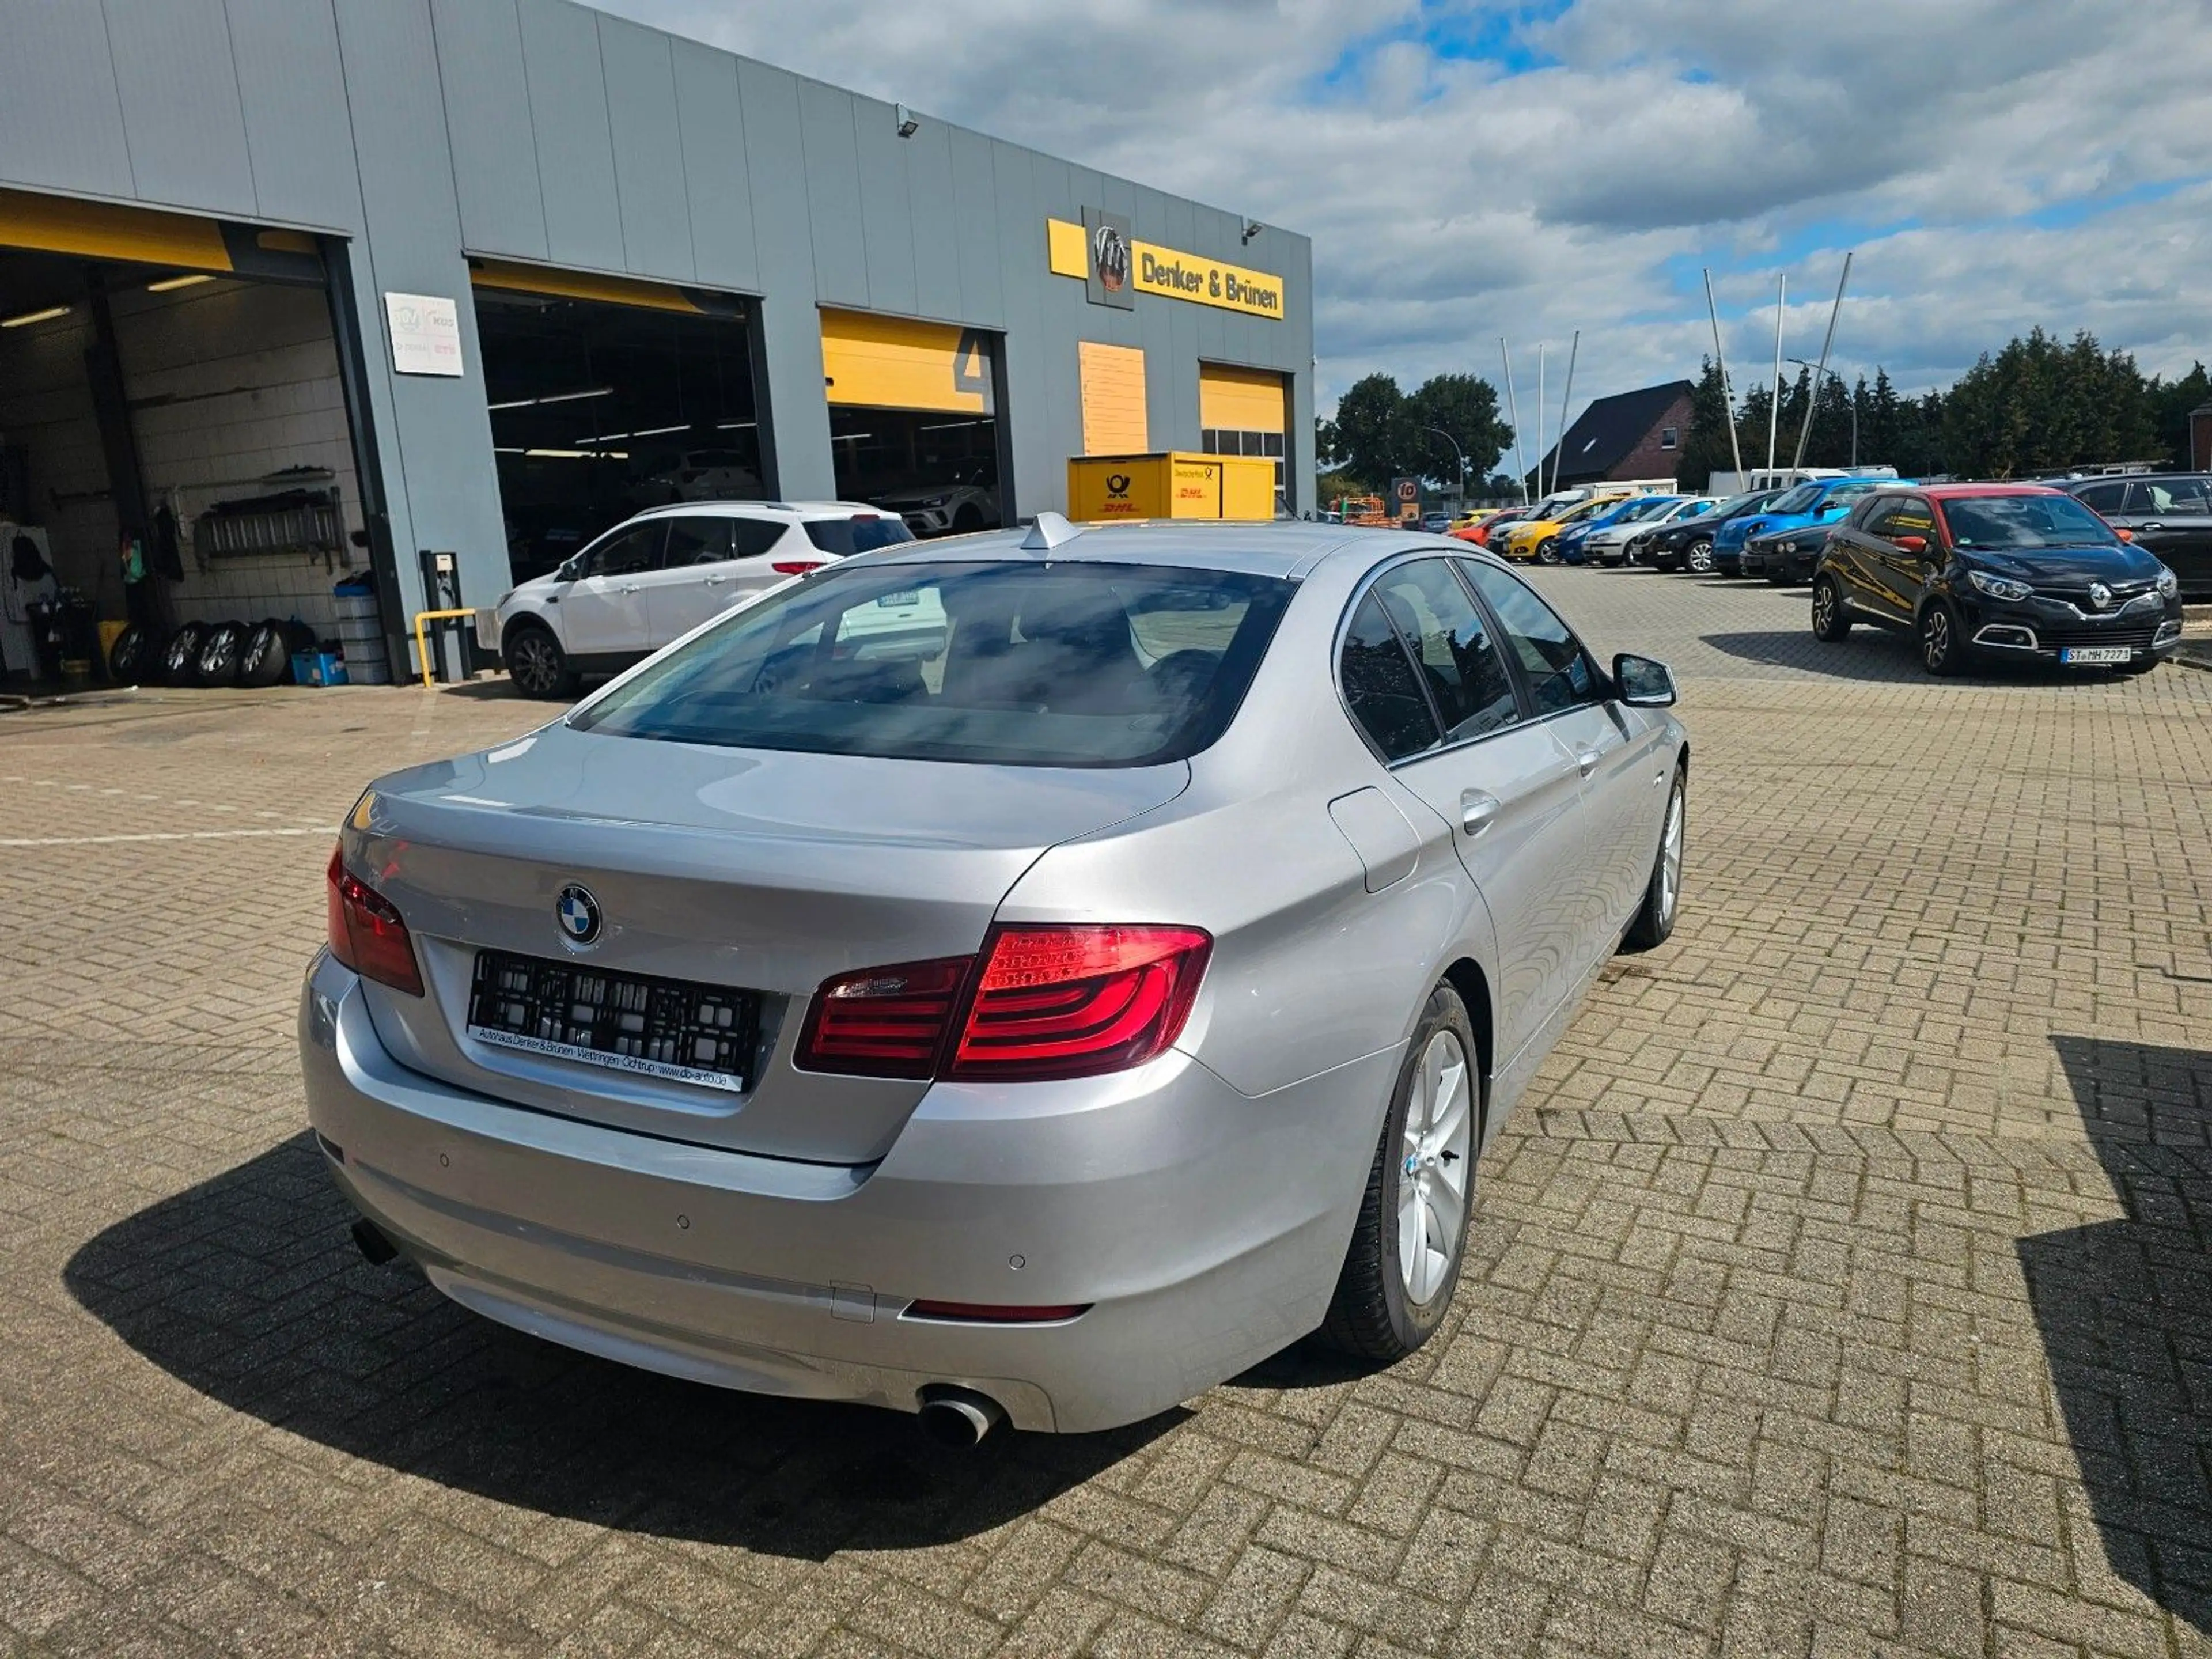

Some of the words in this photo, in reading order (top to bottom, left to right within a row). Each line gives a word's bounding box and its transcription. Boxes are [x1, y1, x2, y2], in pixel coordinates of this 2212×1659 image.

[1142, 252, 1203, 293] Denker
[1210, 269, 1221, 298] &
[1226, 273, 1277, 310] Brünen
[953, 327, 995, 416] 4
[2069, 649, 2081, 660] ST
[479, 1029, 513, 1044] Autohaus
